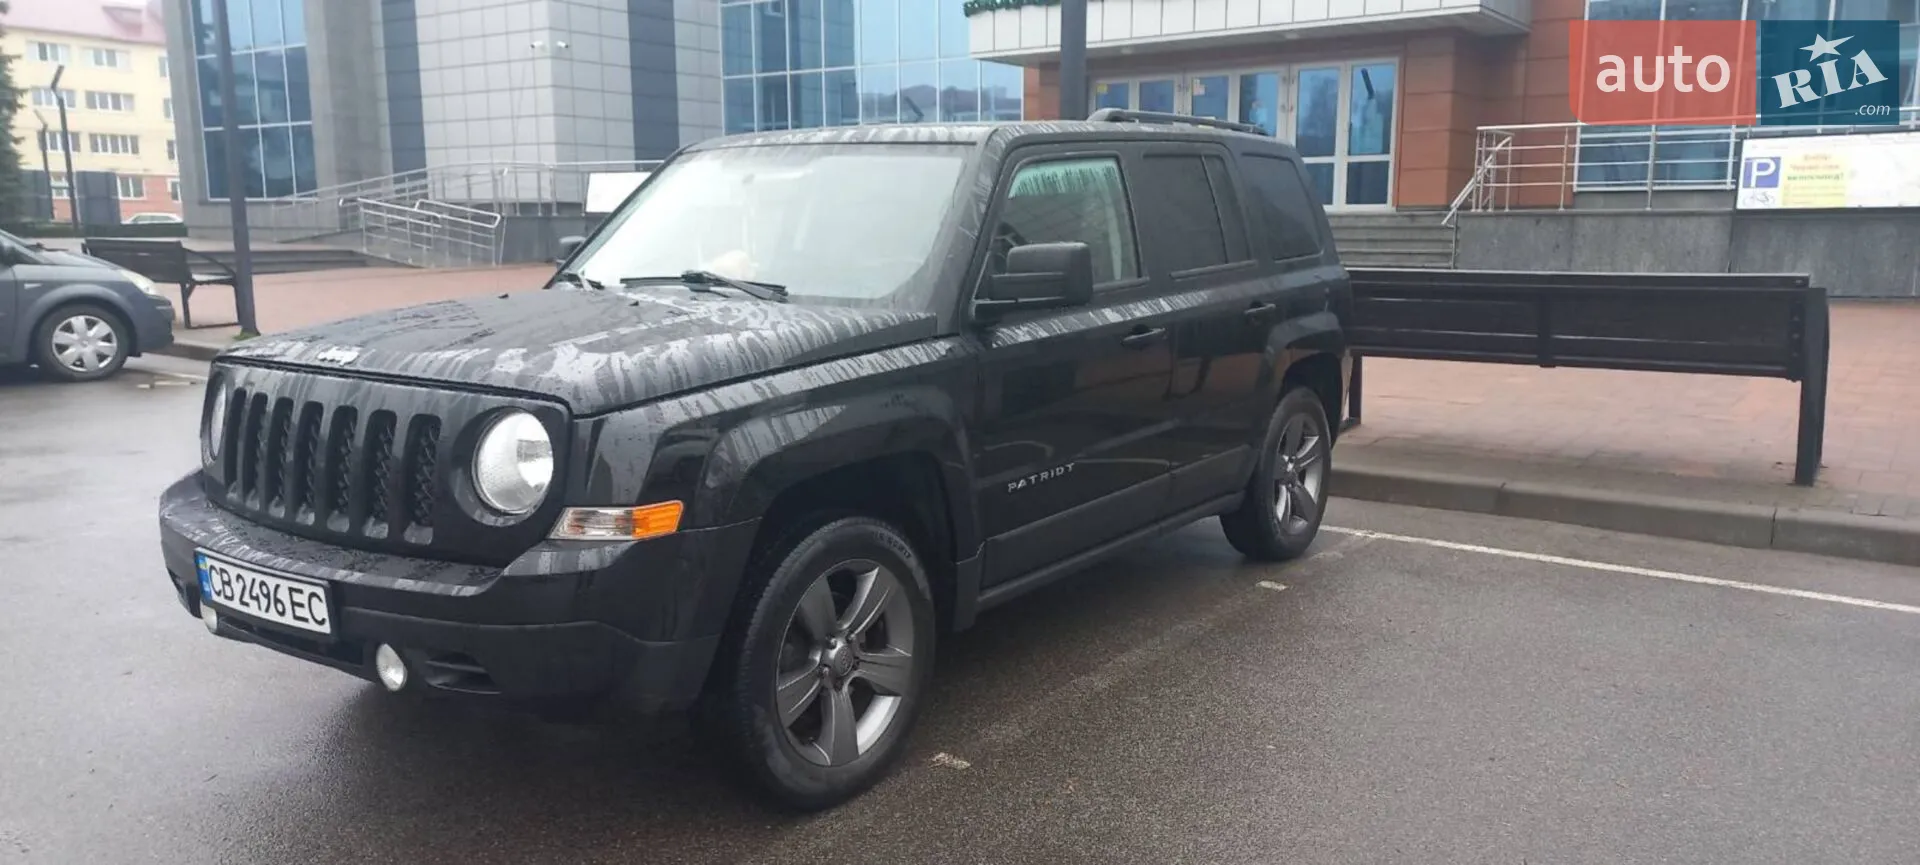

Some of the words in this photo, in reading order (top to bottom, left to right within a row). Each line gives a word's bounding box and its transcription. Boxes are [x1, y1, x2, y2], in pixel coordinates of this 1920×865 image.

[1750, 158, 1777, 188] P
[1007, 462, 1075, 493] PATRIOT
[208, 564, 235, 602] CB
[235, 573, 286, 618] 2496
[288, 585, 327, 627] EC
